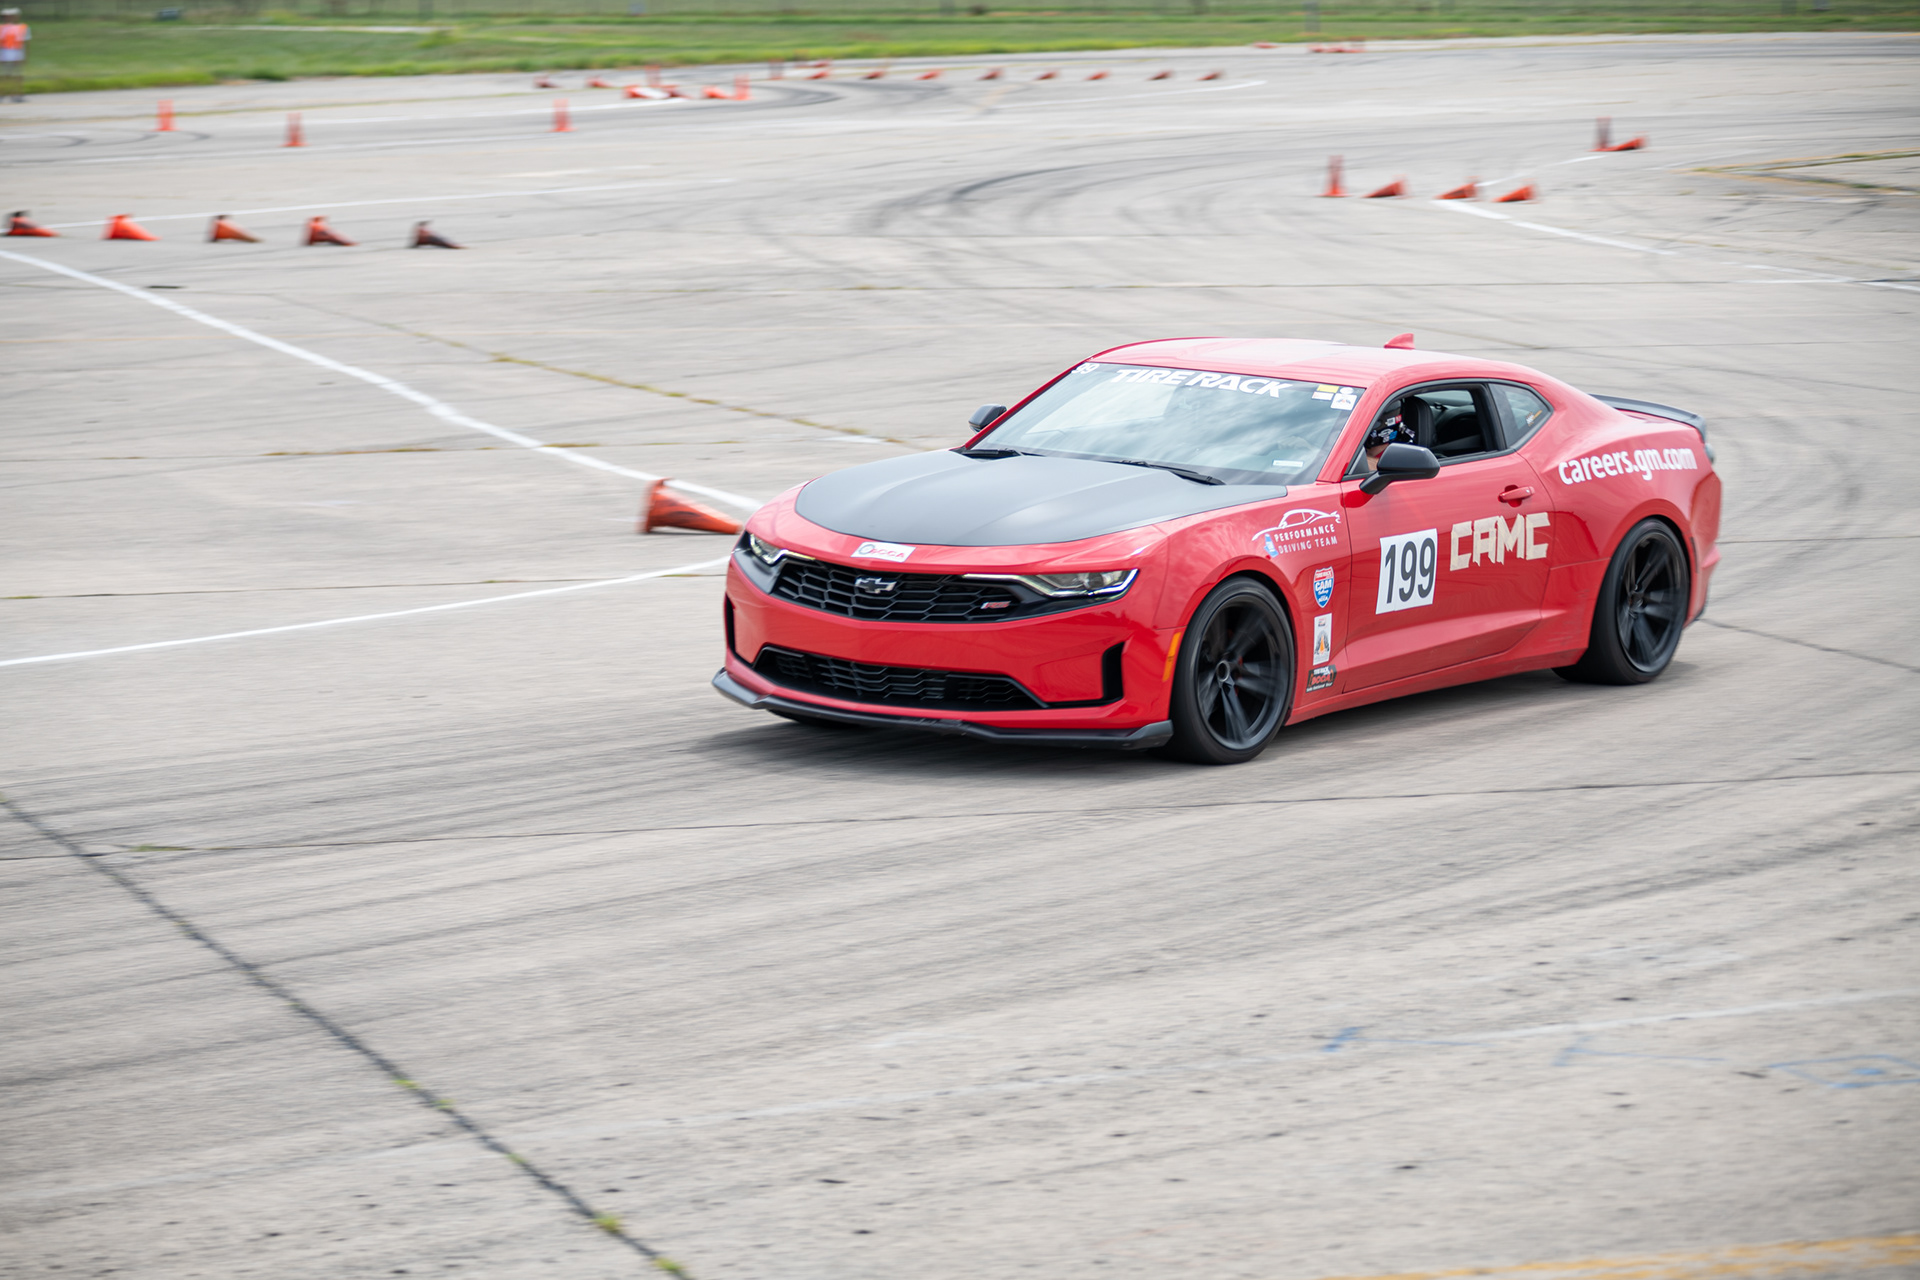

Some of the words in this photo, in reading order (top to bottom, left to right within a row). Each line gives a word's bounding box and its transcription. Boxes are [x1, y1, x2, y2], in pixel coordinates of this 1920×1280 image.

[1110, 368, 1192, 387] TIRE
[1187, 369, 1294, 398] RACK
[1559, 448, 1698, 485] careers.gm.com
[1274, 524, 1335, 542] PERFORMANCE
[1278, 540, 1312, 555] DRIVING
[1315, 536, 1338, 549] TEAM
[1450, 512, 1551, 571] CAMC
[1315, 579, 1332, 592] CAM
[1385, 537, 1436, 604] 199
